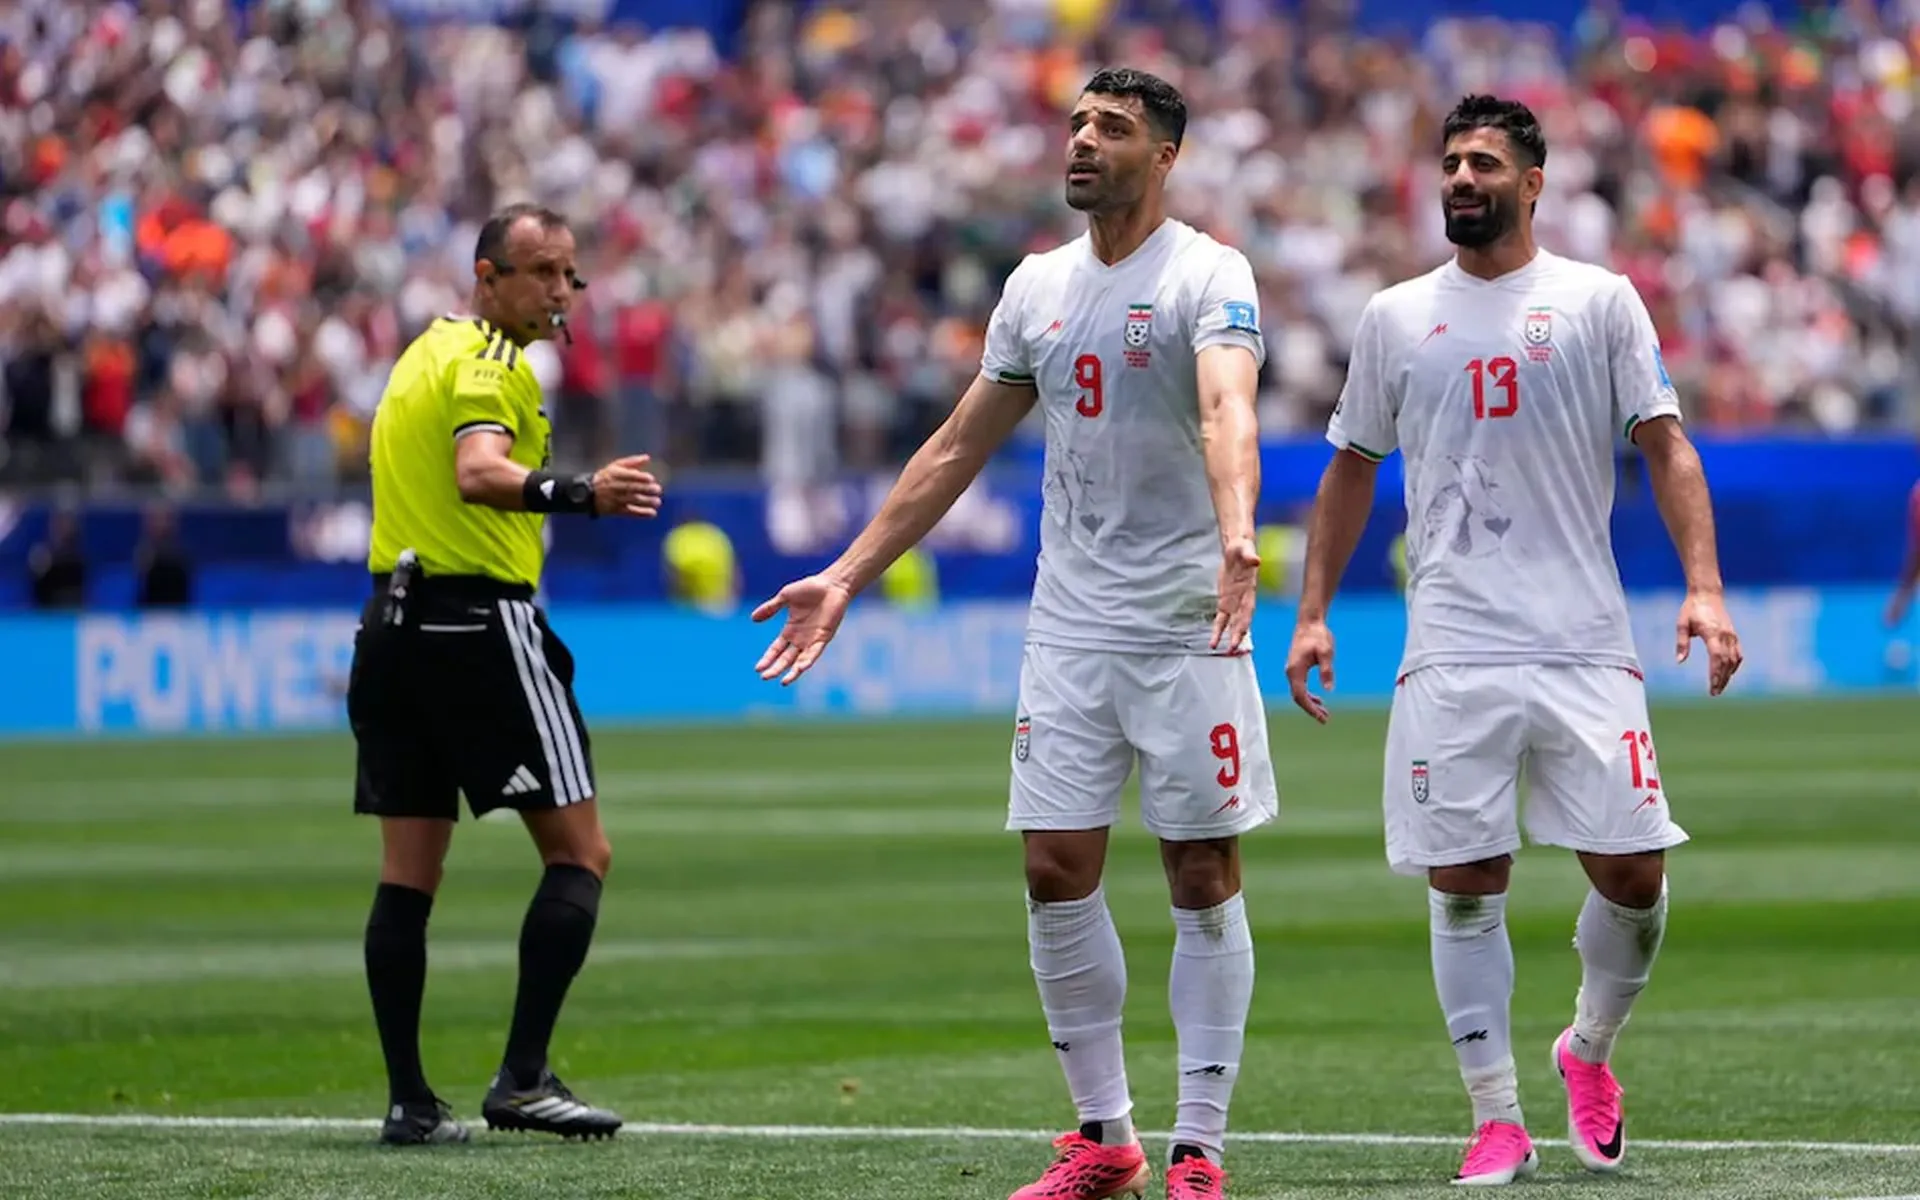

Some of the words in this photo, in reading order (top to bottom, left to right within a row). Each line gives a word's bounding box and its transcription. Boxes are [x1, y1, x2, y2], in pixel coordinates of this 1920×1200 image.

[1075, 354, 1103, 418] 9
[1463, 357, 1518, 420] 13
[1209, 722, 1239, 788] 9
[1620, 730, 1659, 790] 13
